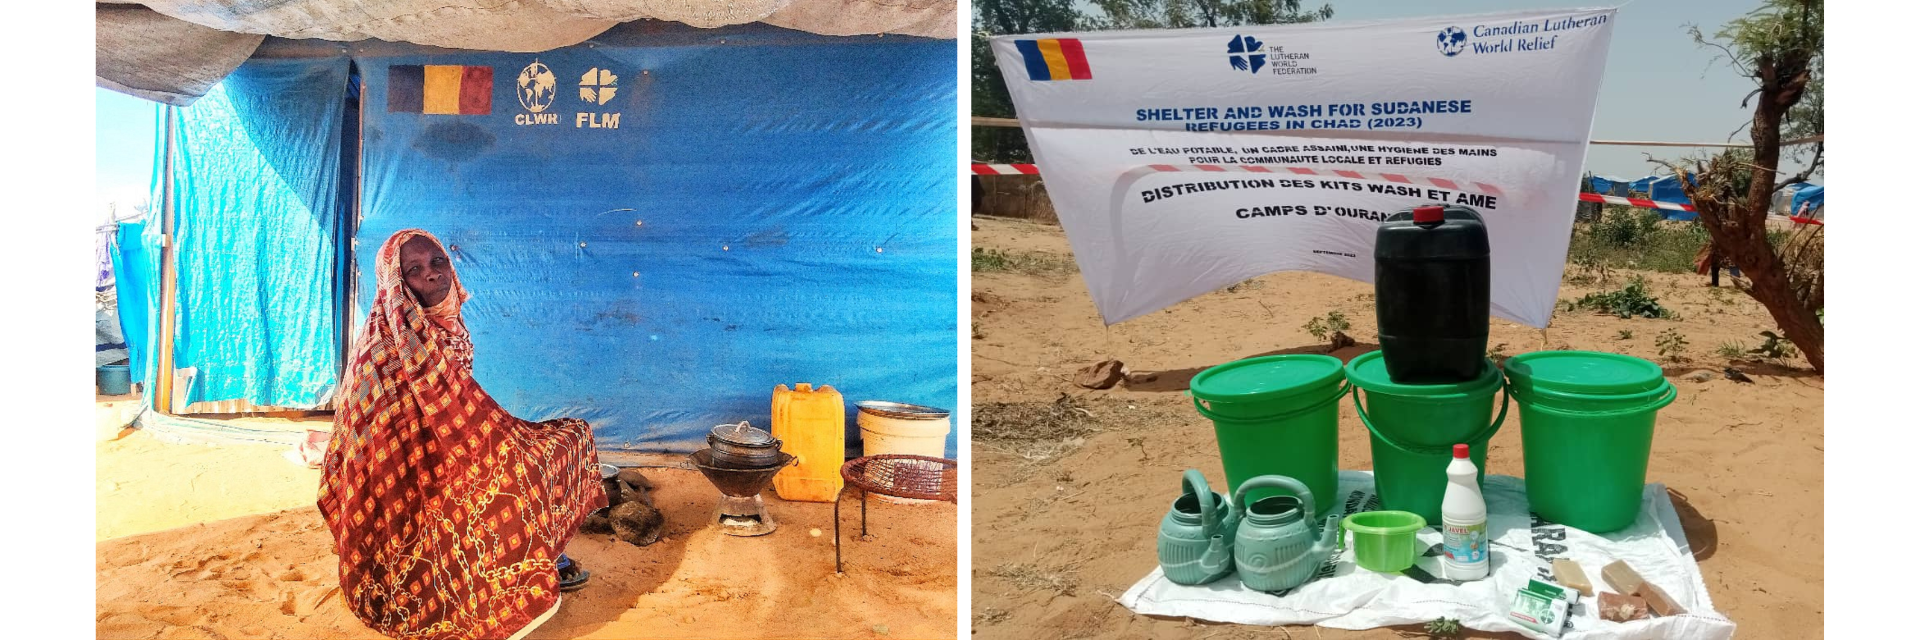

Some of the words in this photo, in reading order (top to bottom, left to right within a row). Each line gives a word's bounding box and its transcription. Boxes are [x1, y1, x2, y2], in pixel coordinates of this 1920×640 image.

[1473, 21, 1538, 38] Canadian
[1544, 14, 1607, 32] Lutheran
[1472, 39, 1512, 54] World
[1518, 35, 1558, 51] Relief
[1273, 67, 1317, 75] FEDERATION
[1136, 107, 1218, 121] SHELTER
[1224, 106, 1262, 120] AND
[1267, 105, 1322, 119] WASH
[1328, 103, 1366, 117] FOR
[1371, 100, 1472, 116] SUDANESE
[576, 112, 621, 129] FLM
[1186, 121, 1280, 132] REFUGEES
[1286, 120, 1305, 130] IN
[1311, 119, 1361, 129] CHAD
[1367, 117, 1423, 130] (2023)
[1129, 147, 1146, 155] DE
[1148, 147, 1181, 155] L'EAU
[1183, 146, 1238, 155] POTABLE,
[1262, 146, 1300, 154] CADRE
[1378, 146, 1429, 155] HYGIENE
[1432, 147, 1455, 155] DES
[1458, 148, 1498, 157] MAINS
[1188, 156, 1223, 164] POUR
[1224, 156, 1238, 164] LA
[1239, 155, 1318, 164] COMMUNAUTE
[1322, 156, 1365, 164] LOCALE
[1368, 156, 1382, 165] ET
[1385, 156, 1442, 166] REFUGIES
[1141, 179, 1275, 203] DISTRIBUTION
[1279, 179, 1315, 188] DES
[1320, 180, 1362, 191] KITS
[1367, 183, 1421, 198] WASH
[1427, 189, 1450, 201] ET
[1456, 192, 1497, 210] AME
[1236, 205, 1308, 219] CAMPS
